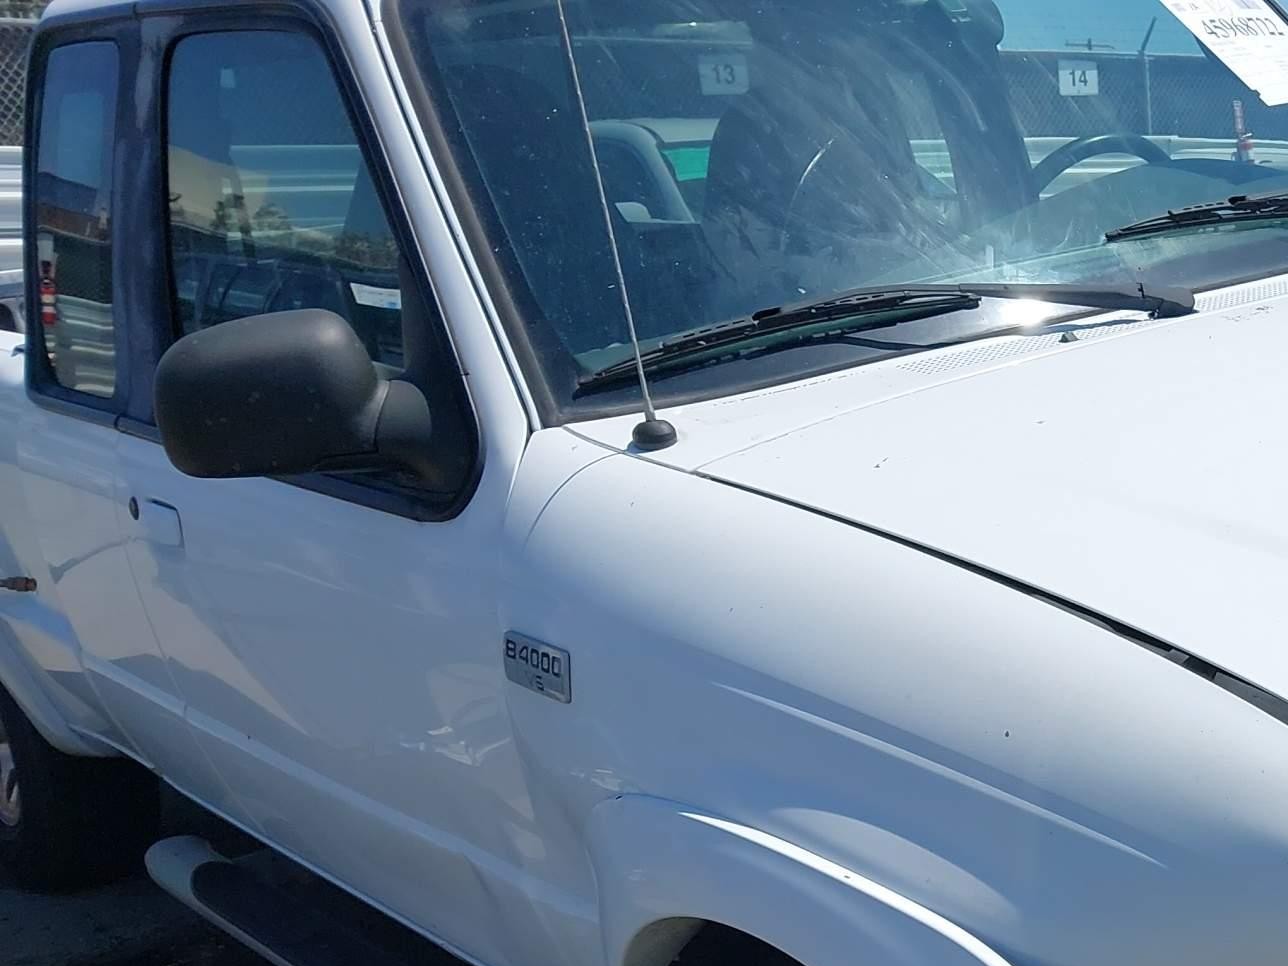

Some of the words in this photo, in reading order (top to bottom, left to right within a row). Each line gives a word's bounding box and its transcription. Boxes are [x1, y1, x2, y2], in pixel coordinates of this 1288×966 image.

[1201, 17, 1285, 39] 45968722
[712, 63, 736, 85] 13
[1069, 69, 1088, 87] 14
